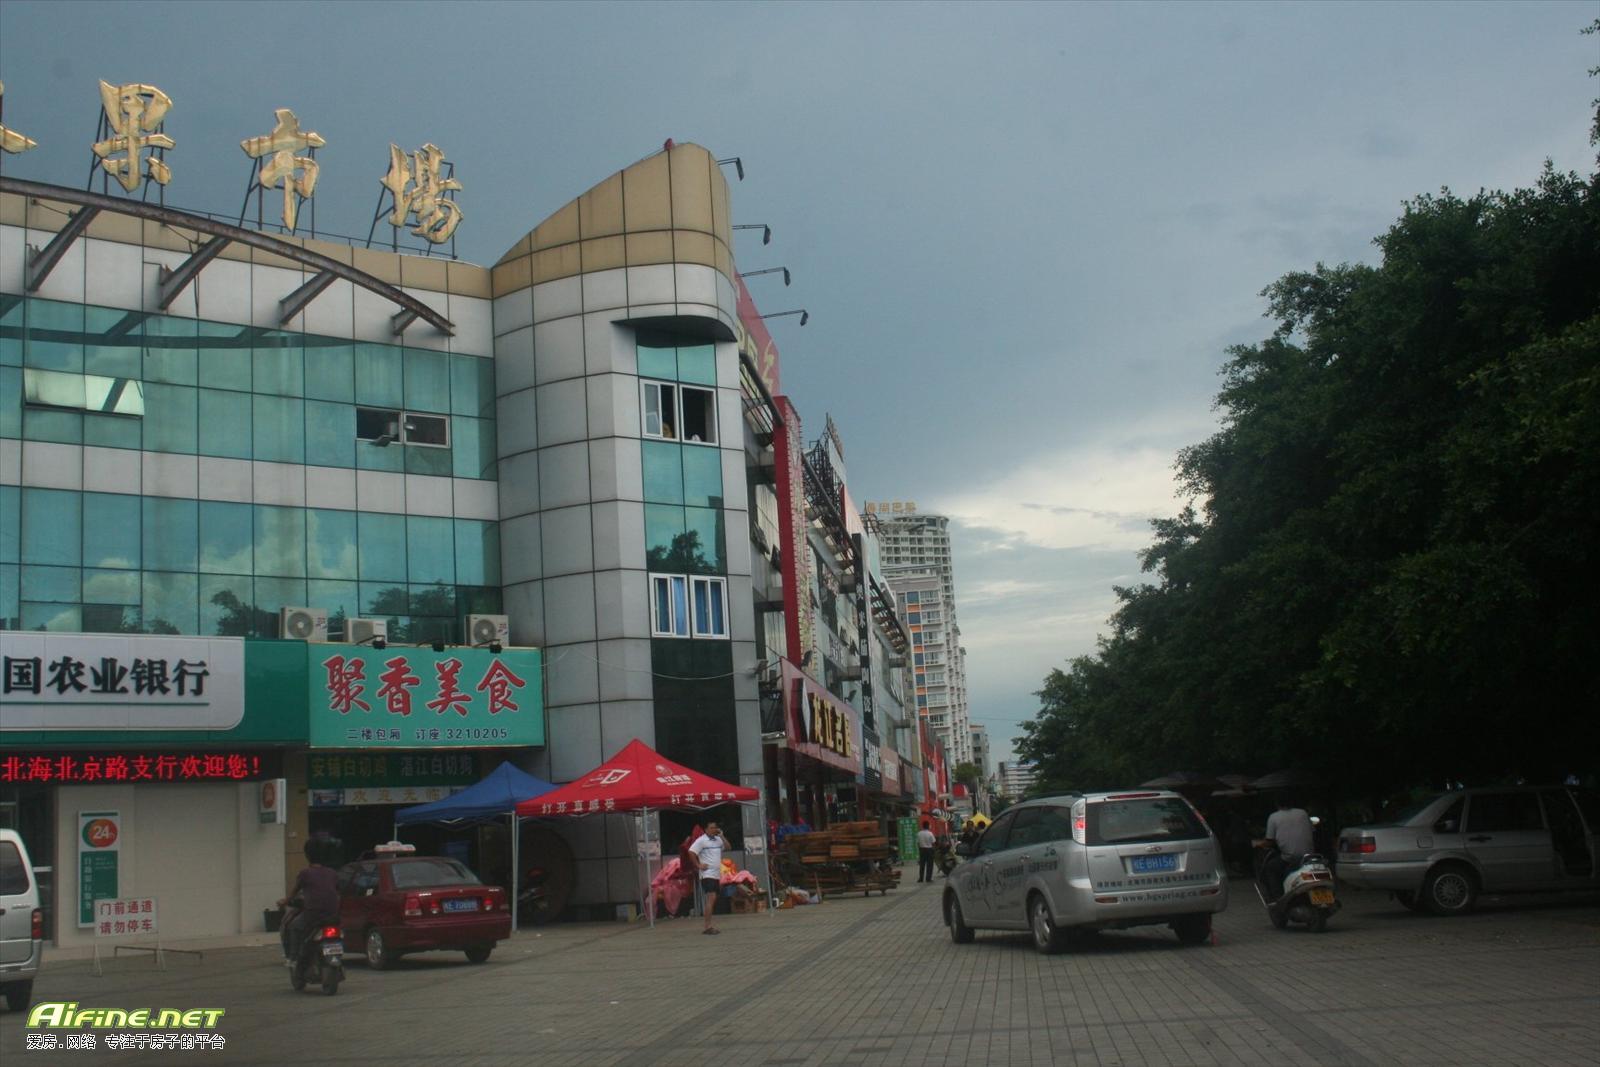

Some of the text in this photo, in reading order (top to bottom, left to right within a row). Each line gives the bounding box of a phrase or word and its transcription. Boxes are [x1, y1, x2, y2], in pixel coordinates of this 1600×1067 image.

[4, 655, 210, 696] 国农业银行
[322, 655, 526, 718] 聚香美食
[347, 728, 508, 743] 二楼包厢 订座 3210205
[100, 900, 153, 916] 门前通道
[99, 918, 153, 935] 请勿停车
